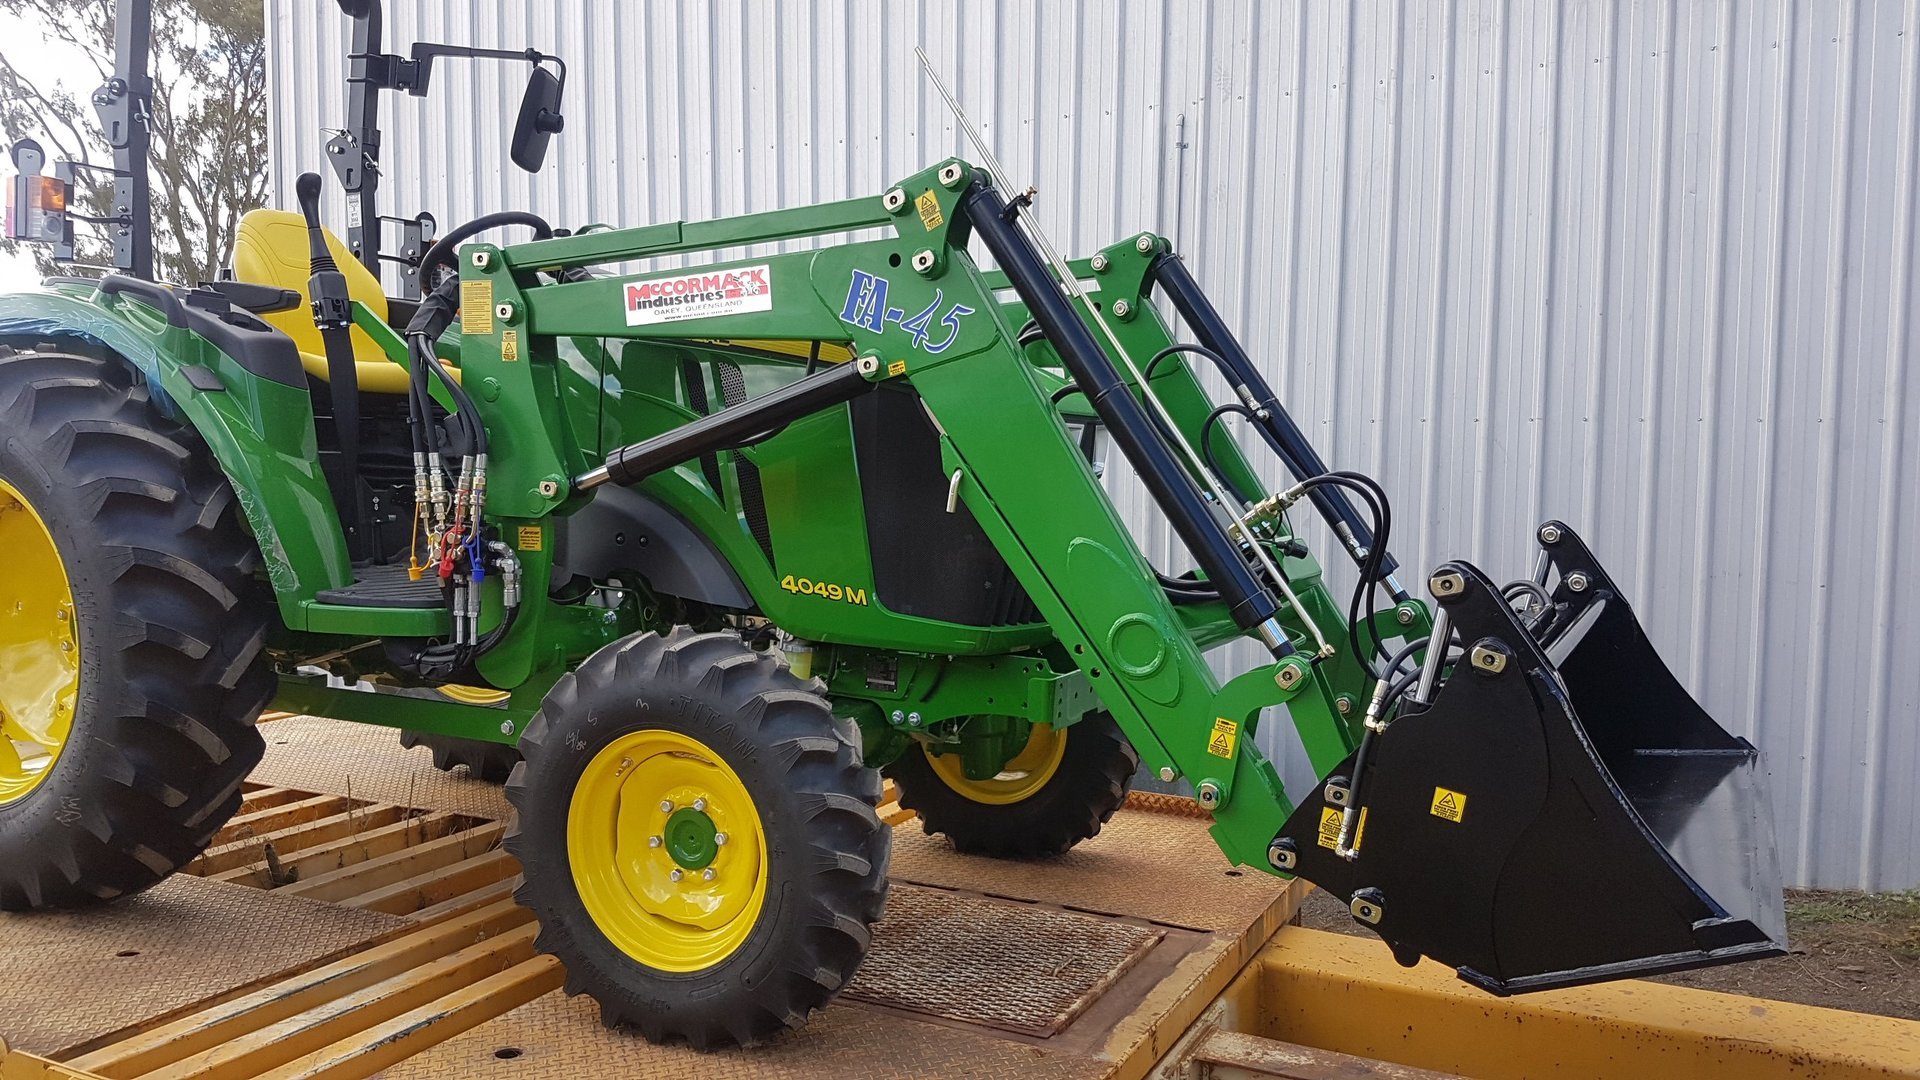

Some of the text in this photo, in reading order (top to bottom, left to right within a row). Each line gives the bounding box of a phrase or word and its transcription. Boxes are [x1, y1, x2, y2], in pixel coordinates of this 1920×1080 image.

[637, 290, 724, 310] industries
[685, 300, 743, 312] QUEENSLAND
[840, 269, 976, 353] FA-45
[678, 695, 758, 761] TITAN
